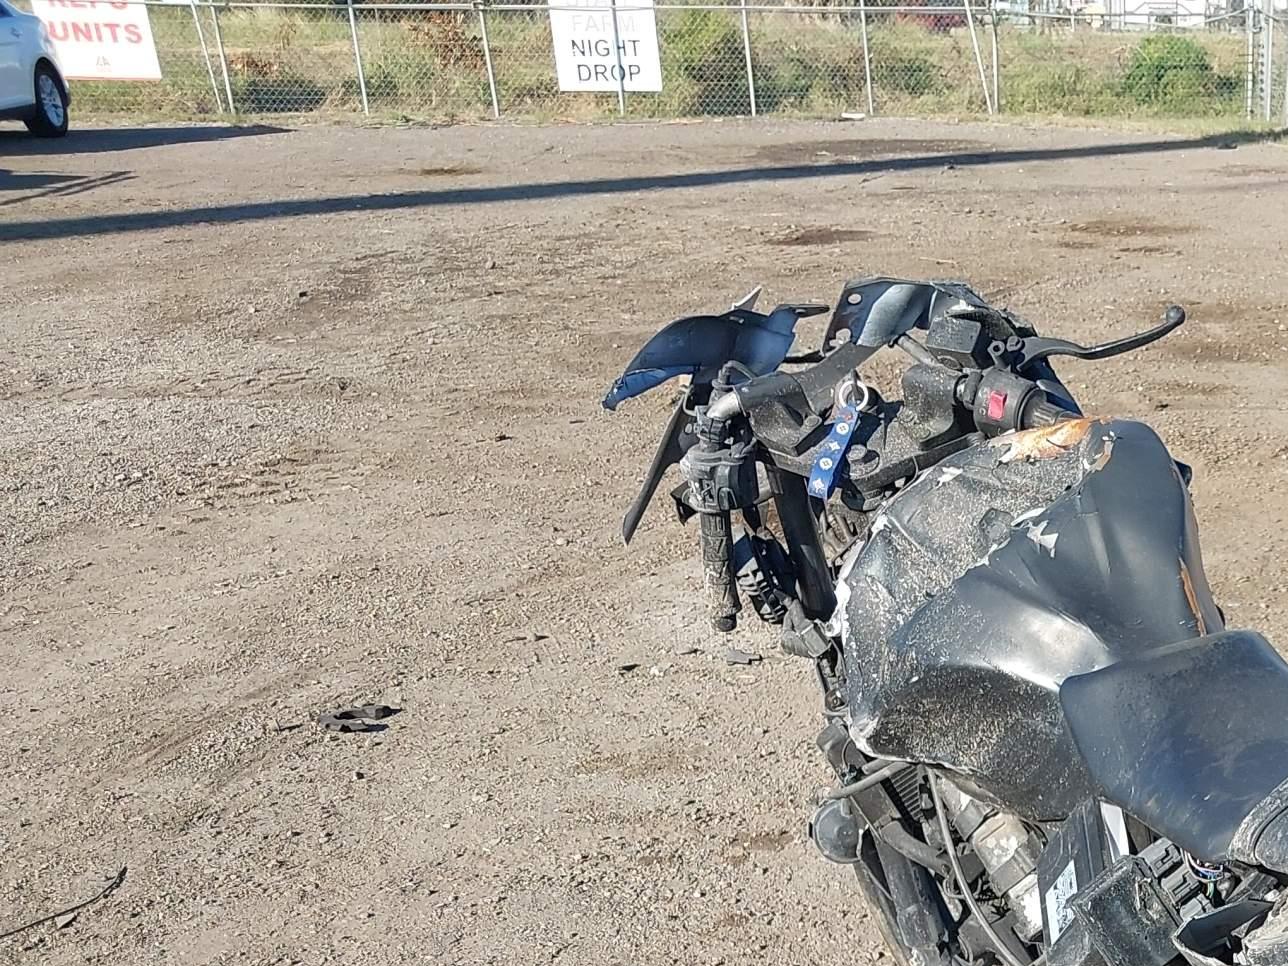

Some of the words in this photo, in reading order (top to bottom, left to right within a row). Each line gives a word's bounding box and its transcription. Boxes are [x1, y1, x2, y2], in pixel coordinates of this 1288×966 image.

[48, 21, 143, 44] UNITS
[571, 39, 640, 57] NIGHT
[577, 64, 640, 82] DROP
